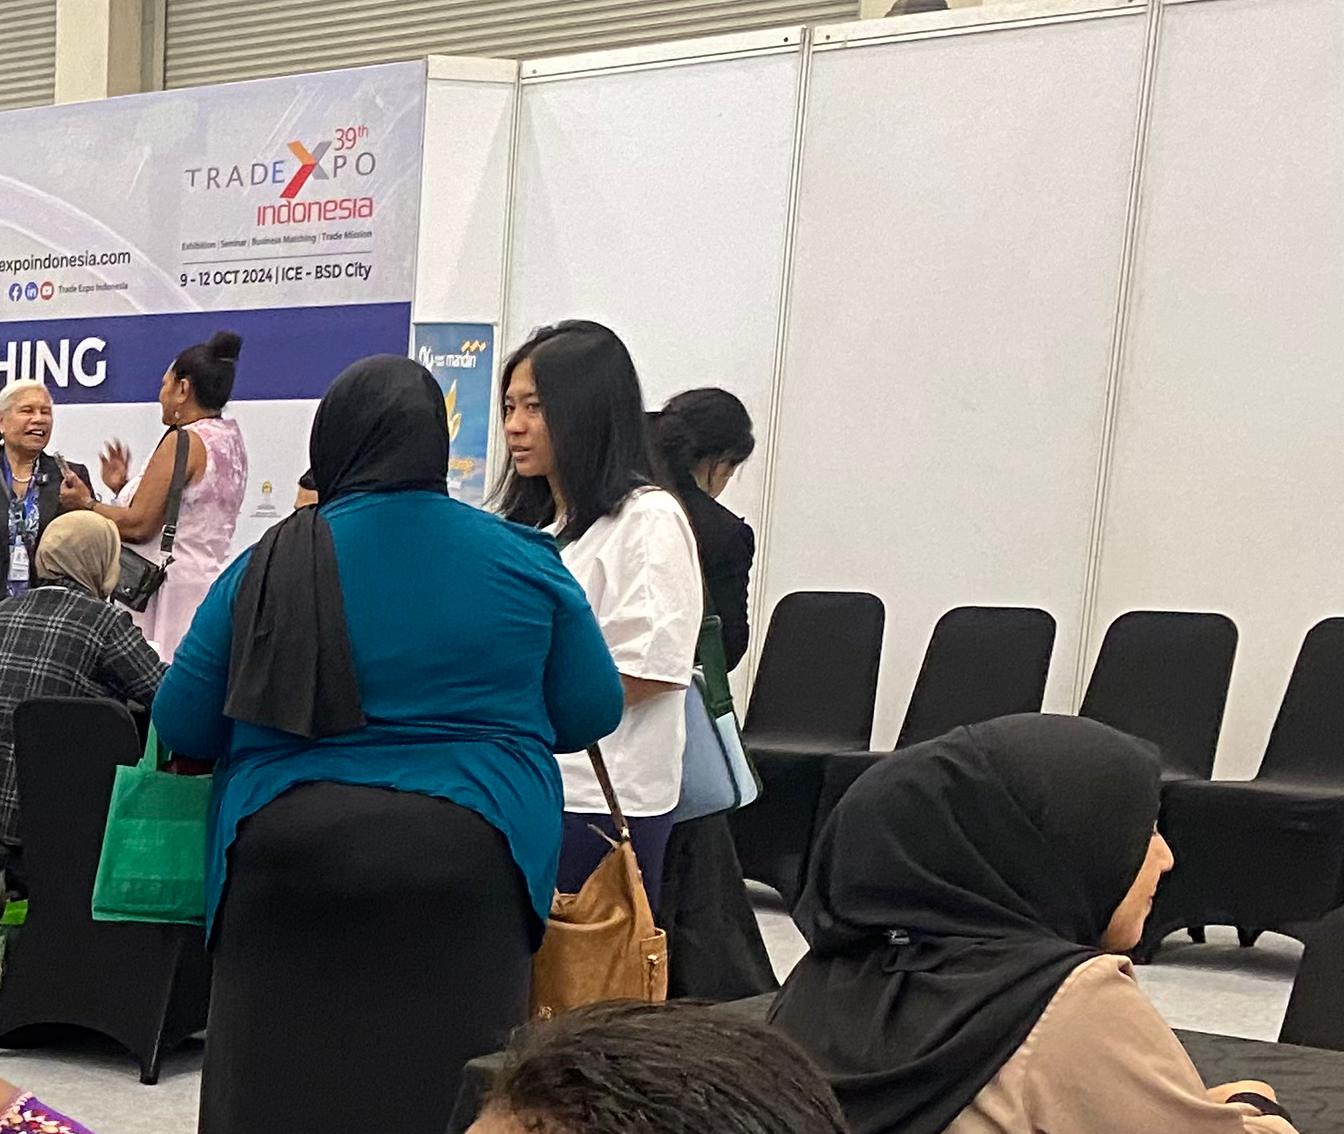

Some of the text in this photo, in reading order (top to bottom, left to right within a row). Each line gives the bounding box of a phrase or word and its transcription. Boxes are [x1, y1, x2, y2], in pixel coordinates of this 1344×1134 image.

[334, 124, 369, 151] 39th
[257, 197, 373, 226] indonesia
[180, 273, 188, 287] 9
[199, 272, 211, 286] 12
[213, 270, 239, 285] OCT
[242, 268, 273, 284] 2024
[281, 266, 303, 281] ICE
[315, 264, 342, 280] BSD
[345, 262, 372, 281] City
